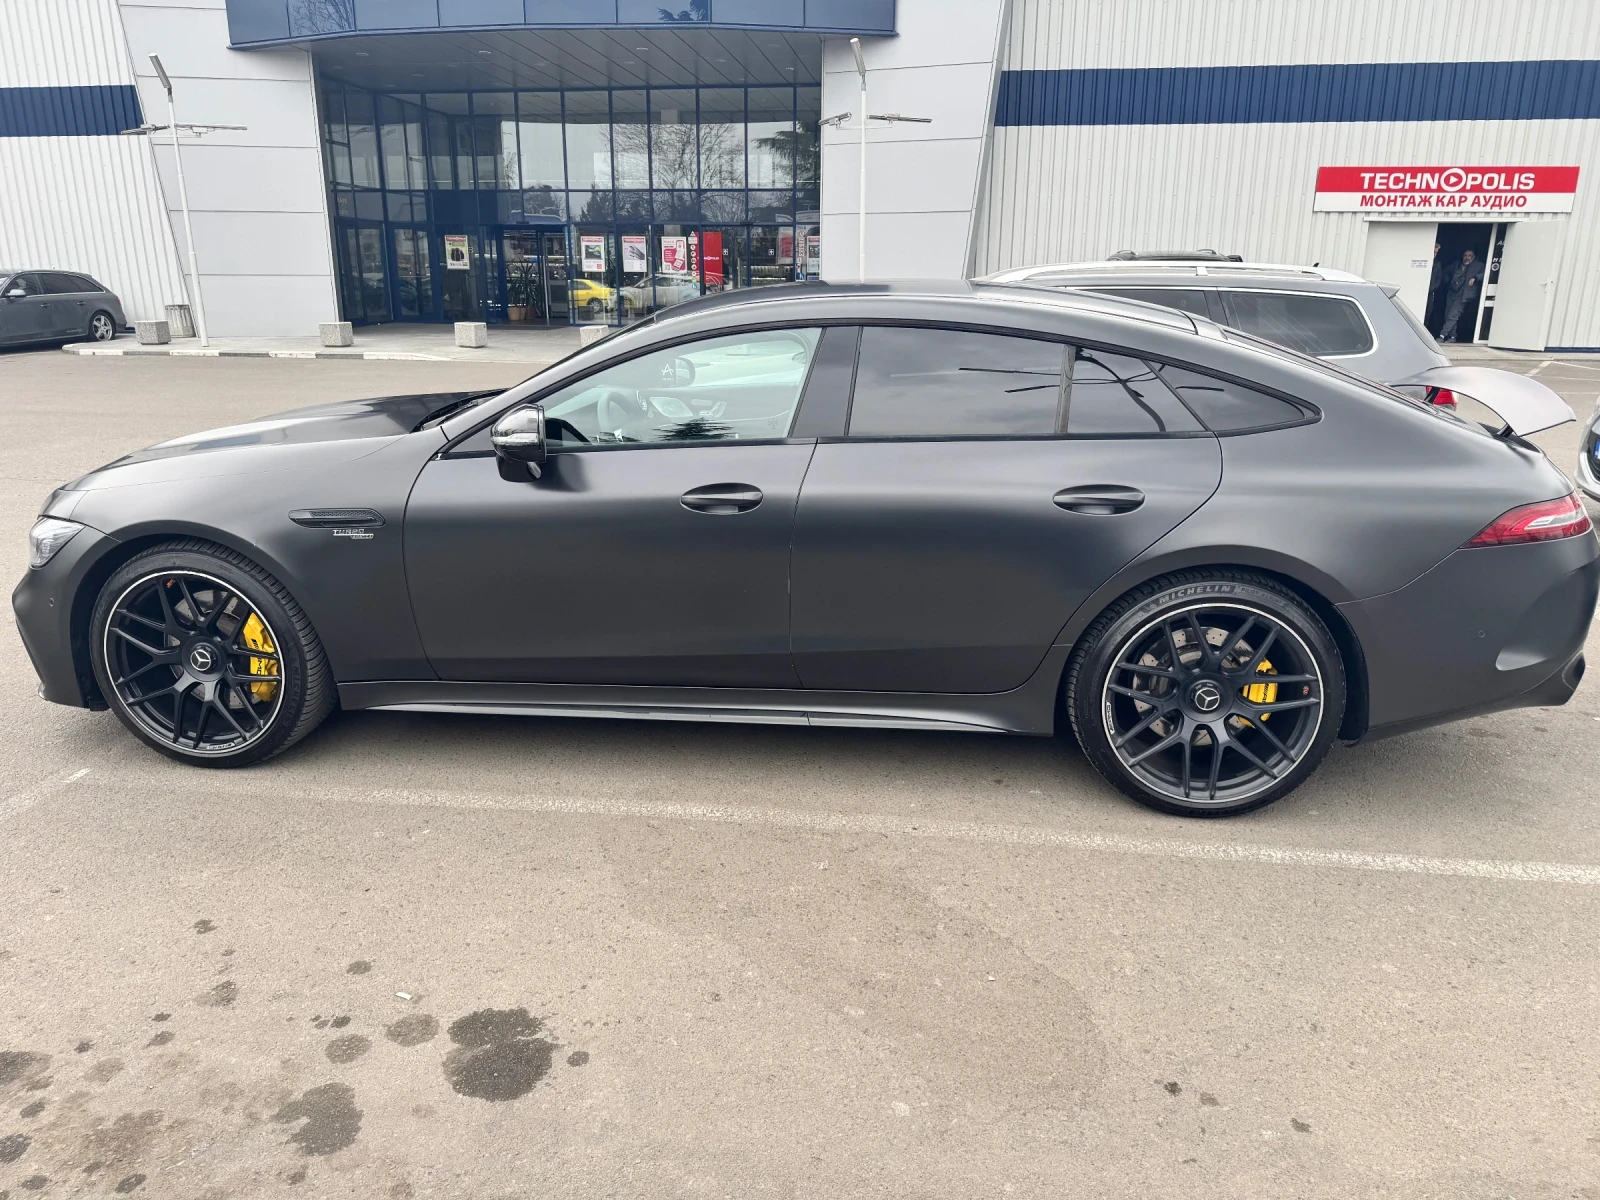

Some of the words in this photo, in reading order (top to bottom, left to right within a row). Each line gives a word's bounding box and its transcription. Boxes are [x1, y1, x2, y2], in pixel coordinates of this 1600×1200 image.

[1360, 167, 1536, 192] TECHNOPOLIS
[1360, 195, 1434, 208] МОНТАЖ
[1435, 195, 1468, 208] КАР
[1470, 195, 1528, 210] АУДИО
[1158, 585, 1232, 604] MICHELIN
